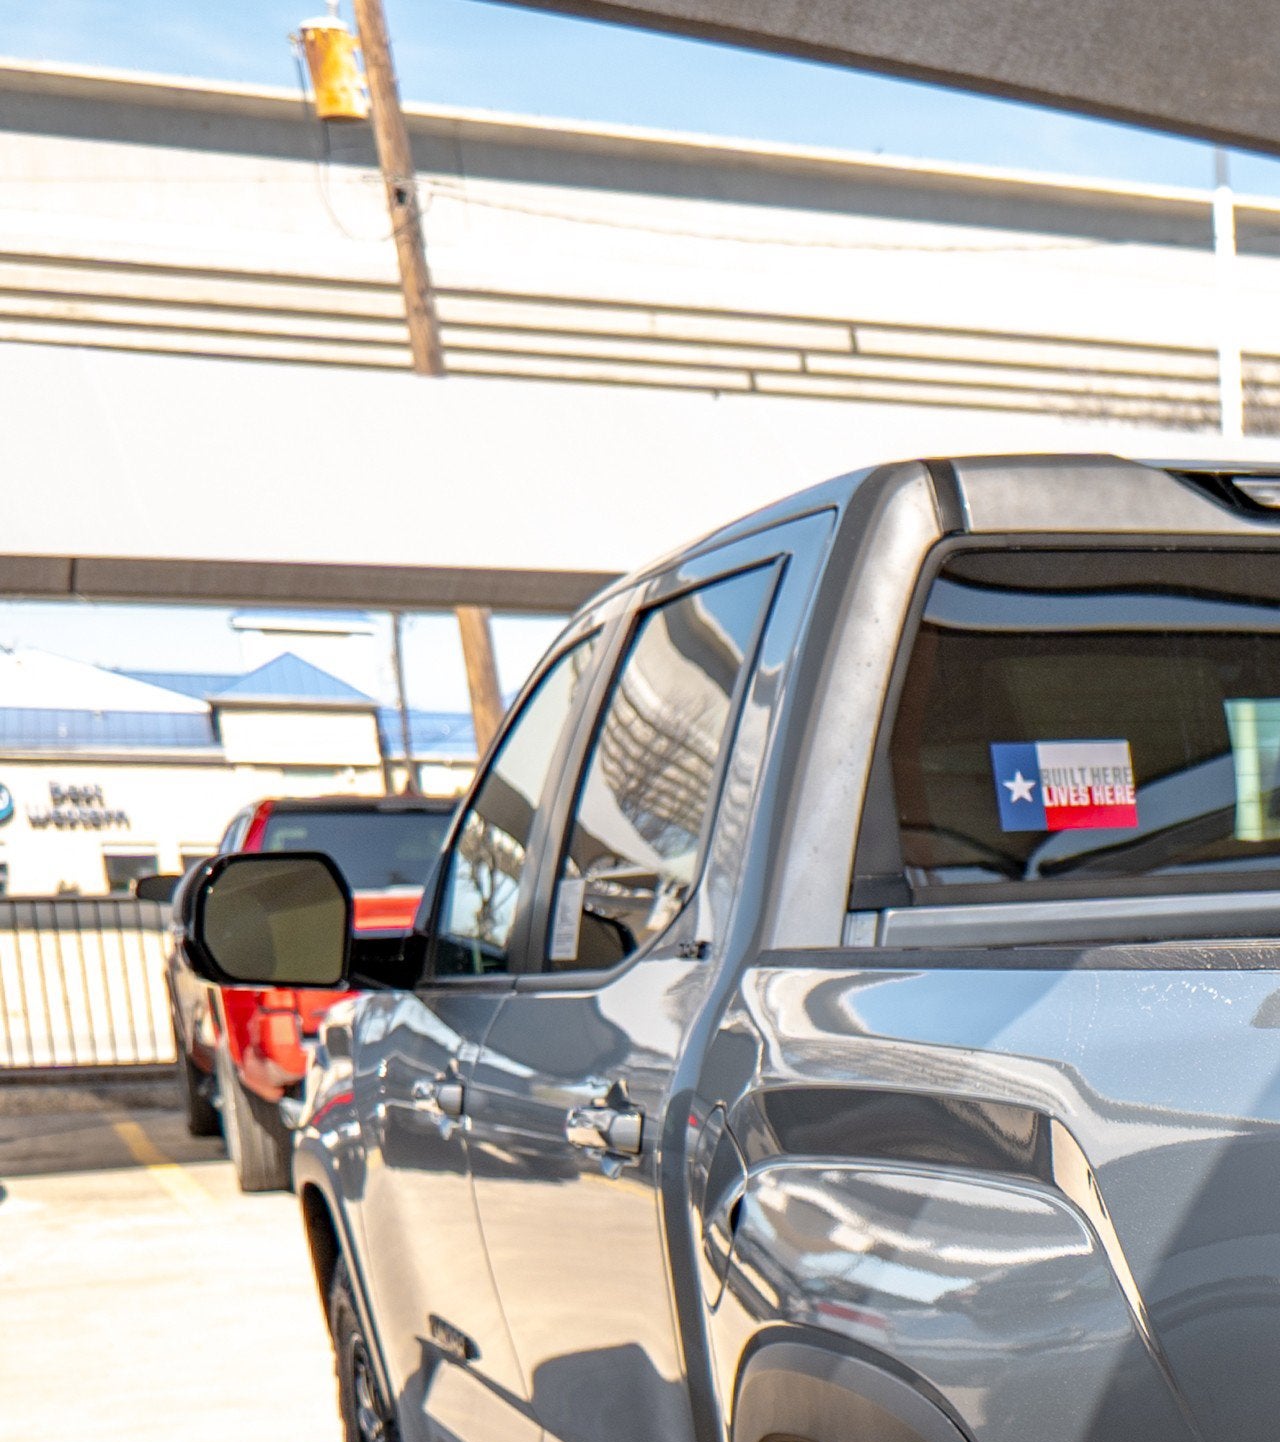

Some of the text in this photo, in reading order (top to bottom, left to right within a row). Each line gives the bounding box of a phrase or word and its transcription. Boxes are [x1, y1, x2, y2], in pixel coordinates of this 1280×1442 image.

[1041, 766, 1131, 787] BUILT HERE
[1042, 785, 1136, 807] LIVES HERE
